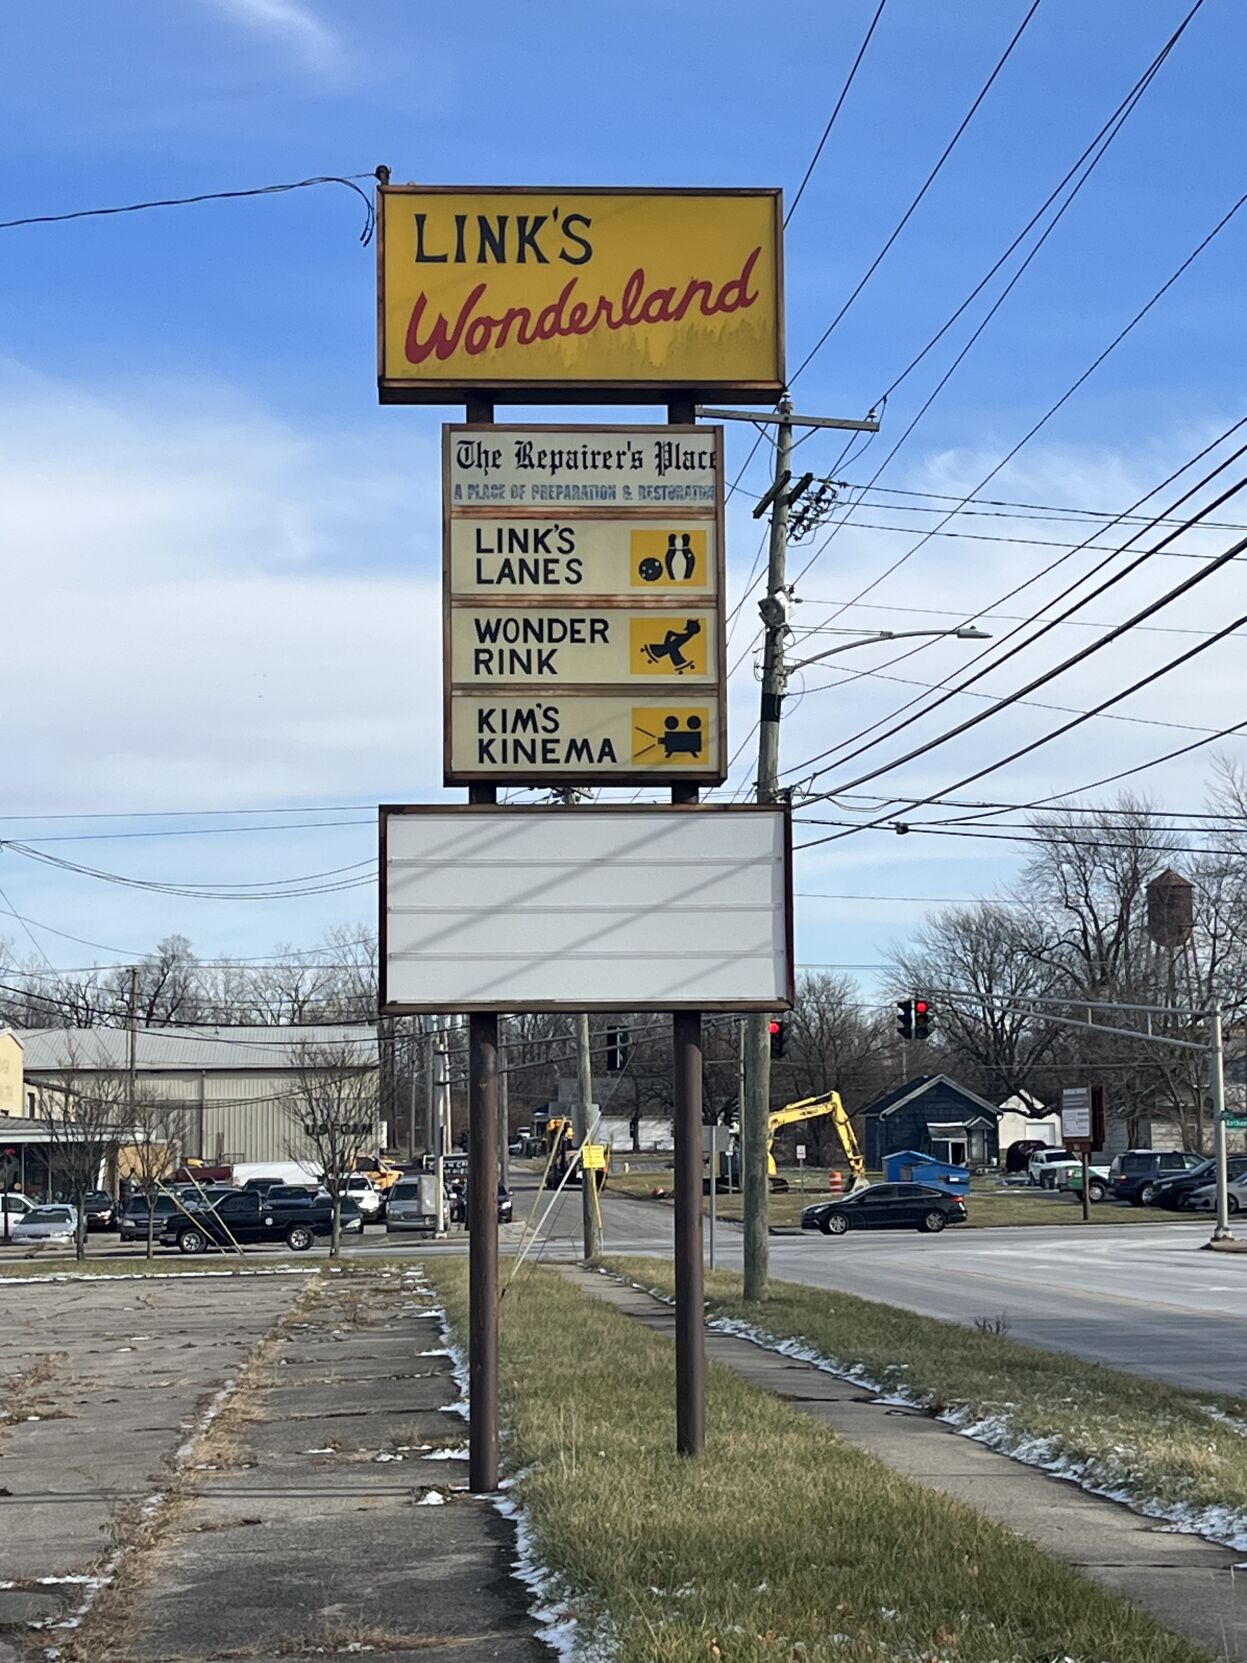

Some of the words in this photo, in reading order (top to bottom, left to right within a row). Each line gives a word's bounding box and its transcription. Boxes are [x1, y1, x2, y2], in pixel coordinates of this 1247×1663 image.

[414, 206, 593, 265] LINK'S
[404, 246, 762, 365] Wonderland
[457, 440, 503, 476] The
[514, 440, 644, 476] Repairer's
[654, 440, 717, 477] Place
[454, 484, 463, 500] A
[467, 484, 506, 500] PLACE
[510, 484, 527, 500] OF
[532, 484, 617, 501] PREPARATION
[623, 485, 634, 500] &
[475, 523, 576, 555] LINK'S
[475, 557, 583, 585] LANES
[474, 617, 610, 644] WONDER
[474, 648, 558, 675] RINK
[477, 702, 560, 734] KIM'S
[478, 737, 618, 764] KINEMA
